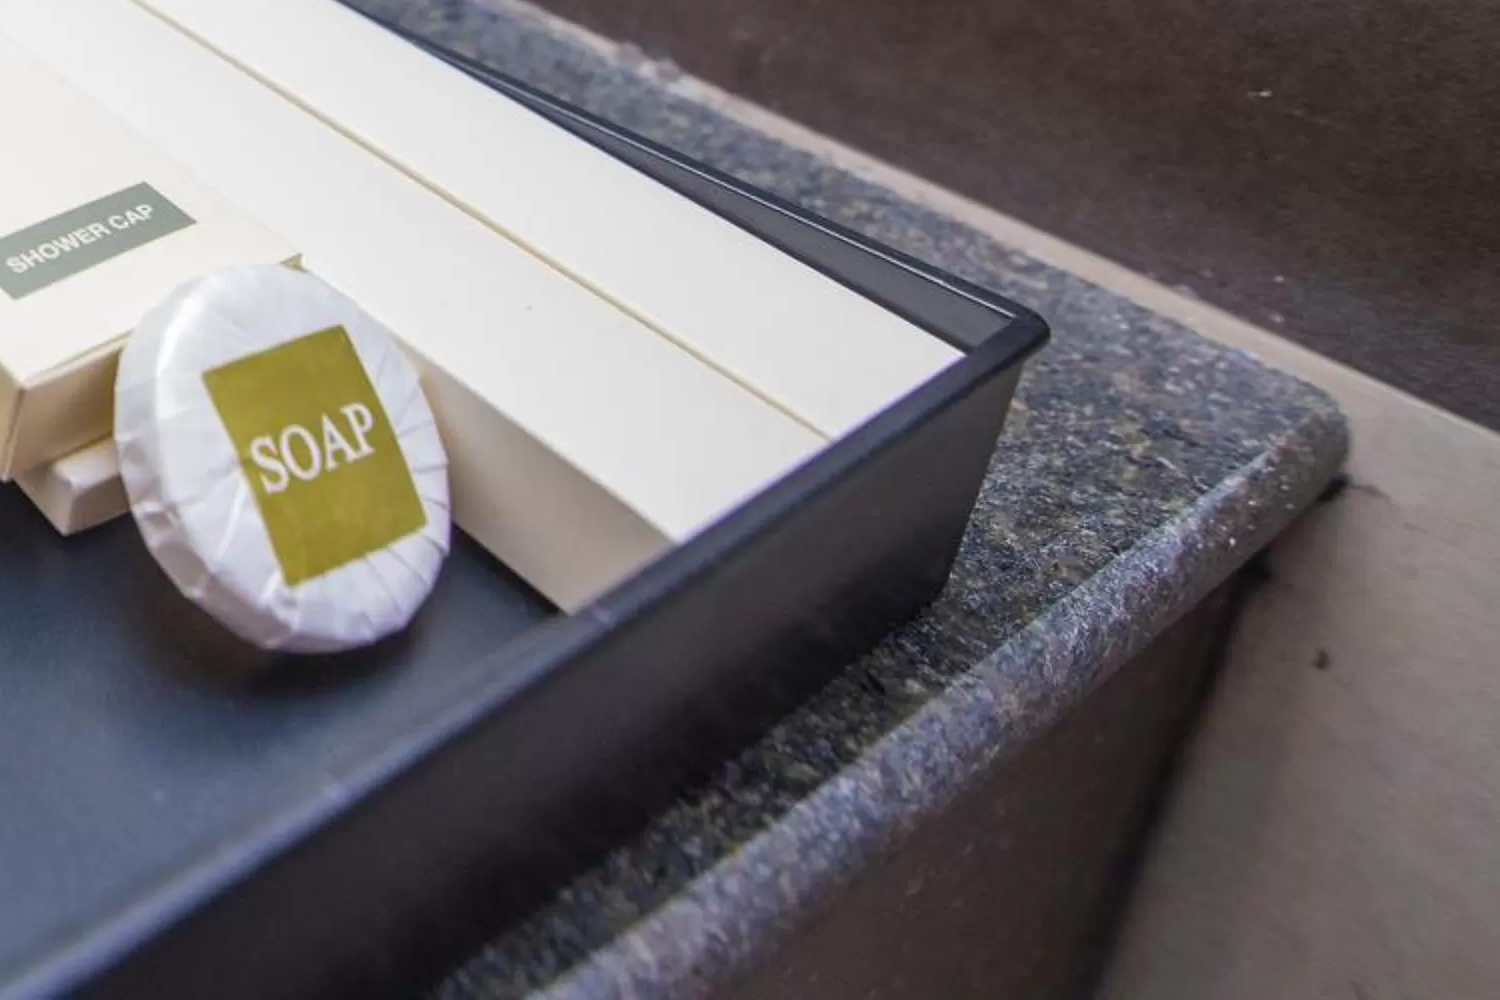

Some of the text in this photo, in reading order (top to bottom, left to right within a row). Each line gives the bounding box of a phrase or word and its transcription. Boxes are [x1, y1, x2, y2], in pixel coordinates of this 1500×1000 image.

[5, 202, 154, 274] SHOWER CAP
[250, 401, 373, 497] SOAP
